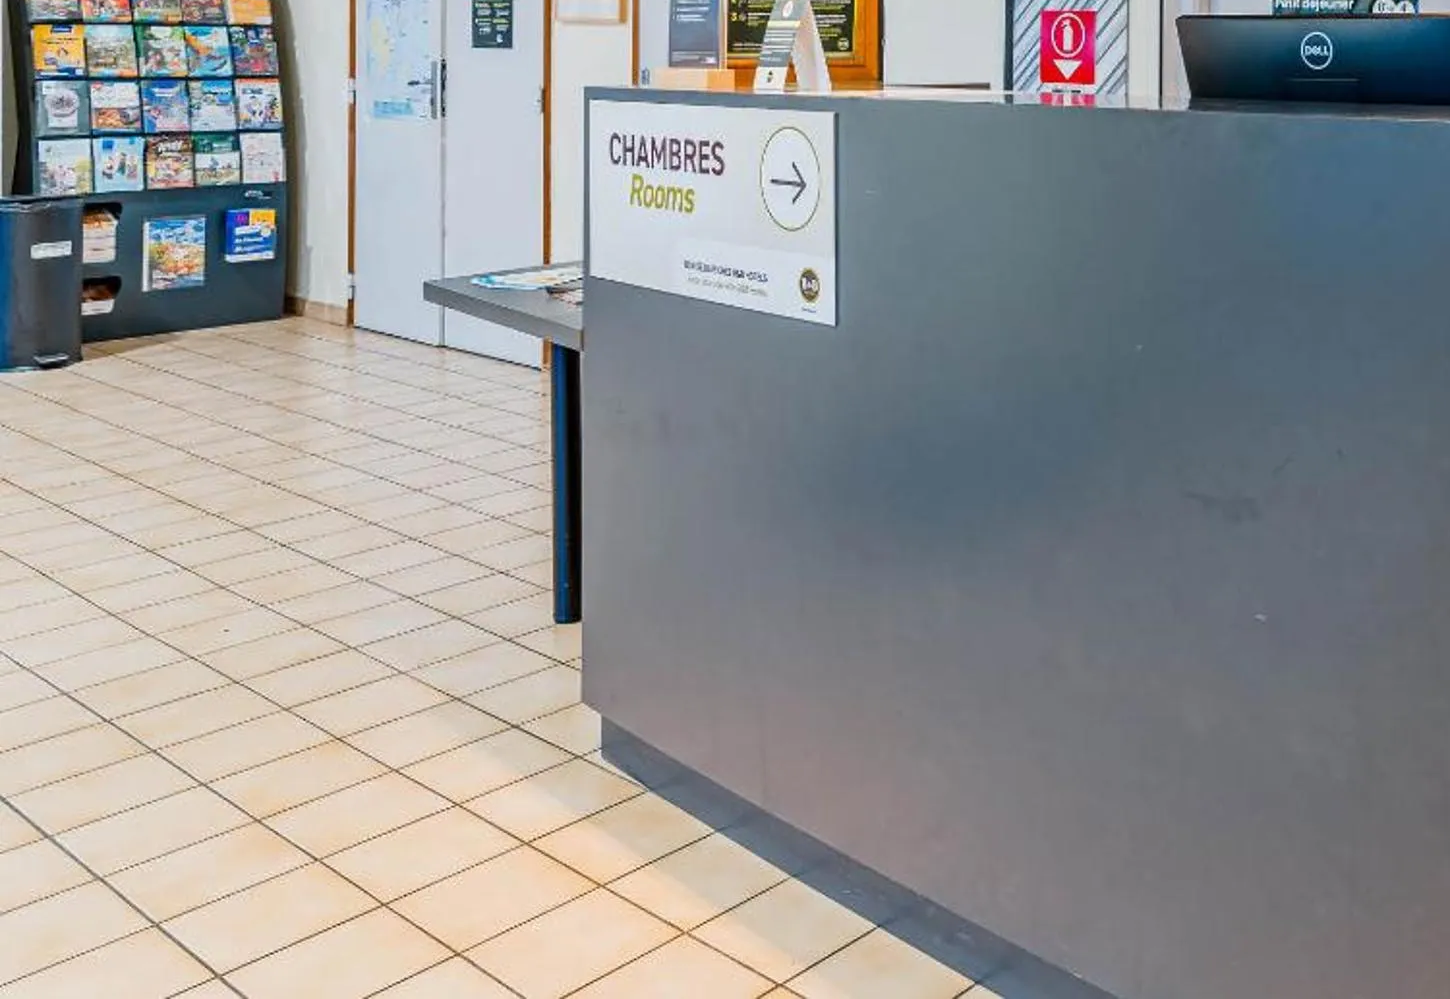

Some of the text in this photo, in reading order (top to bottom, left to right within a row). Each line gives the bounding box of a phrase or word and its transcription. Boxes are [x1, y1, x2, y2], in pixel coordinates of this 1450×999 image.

[1304, 45, 1329, 56] DELL
[609, 132, 726, 176] CHAMBRES
[629, 173, 696, 214] Rooms
